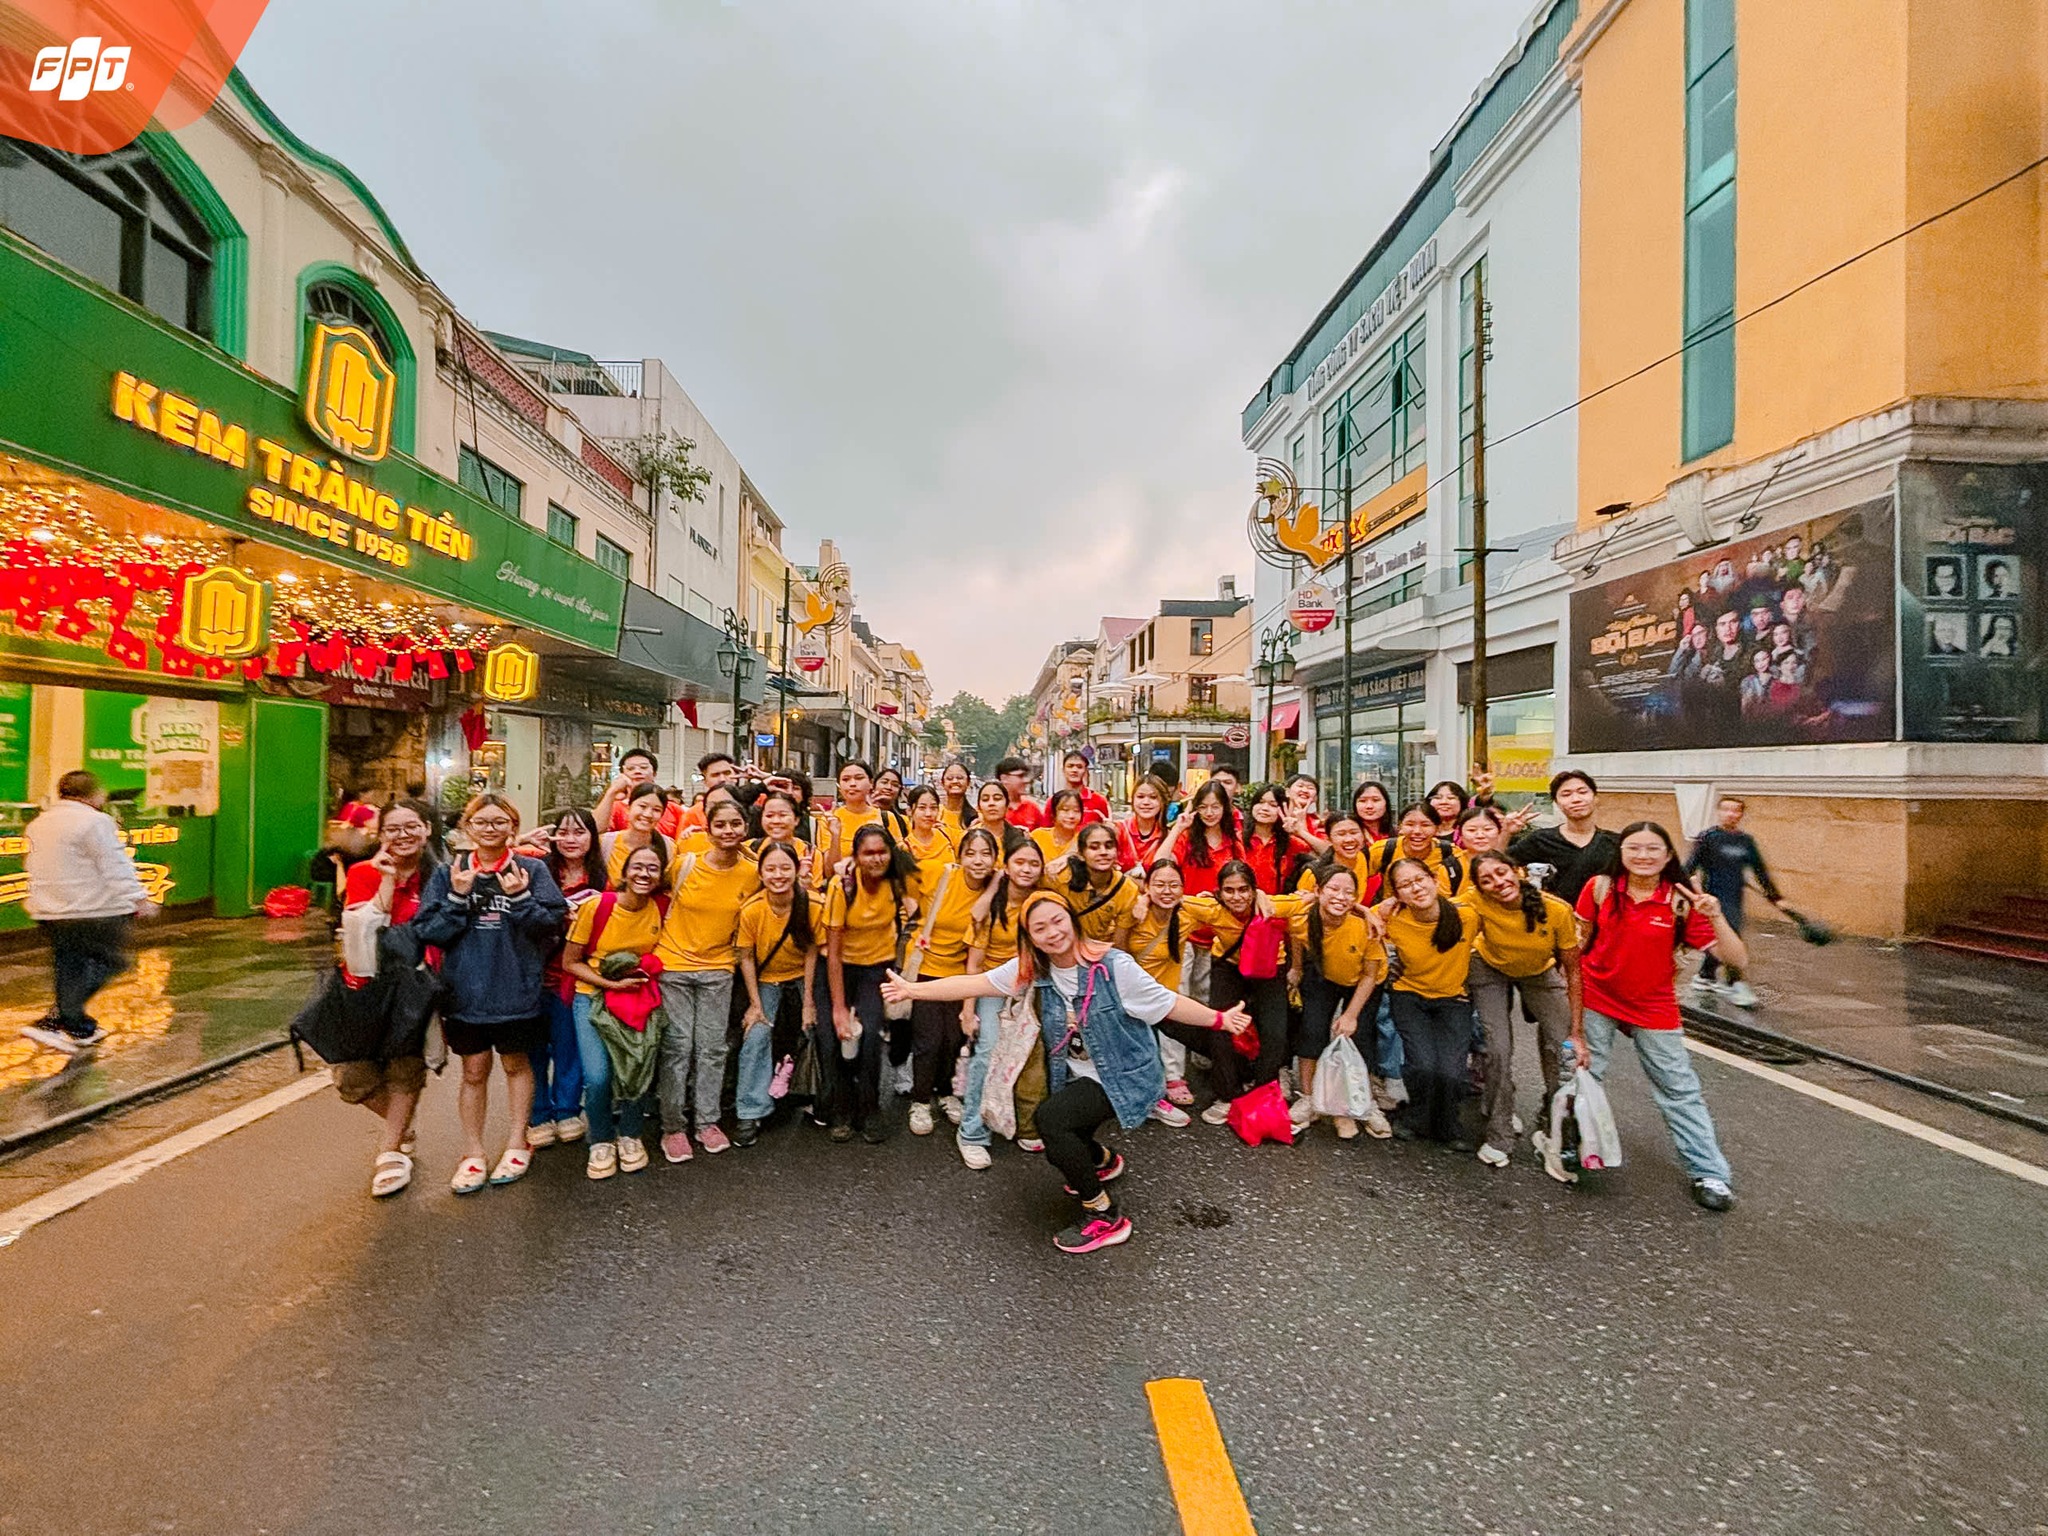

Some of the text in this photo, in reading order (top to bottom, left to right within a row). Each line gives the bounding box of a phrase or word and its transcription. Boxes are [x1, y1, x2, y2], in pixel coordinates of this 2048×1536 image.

[113, 369, 474, 562] KEM TRÀNG TIỀN
[249, 486, 411, 568] SINCE 1958
[1298, 591, 1312, 599] HD
[1298, 600, 1323, 608] Bank
